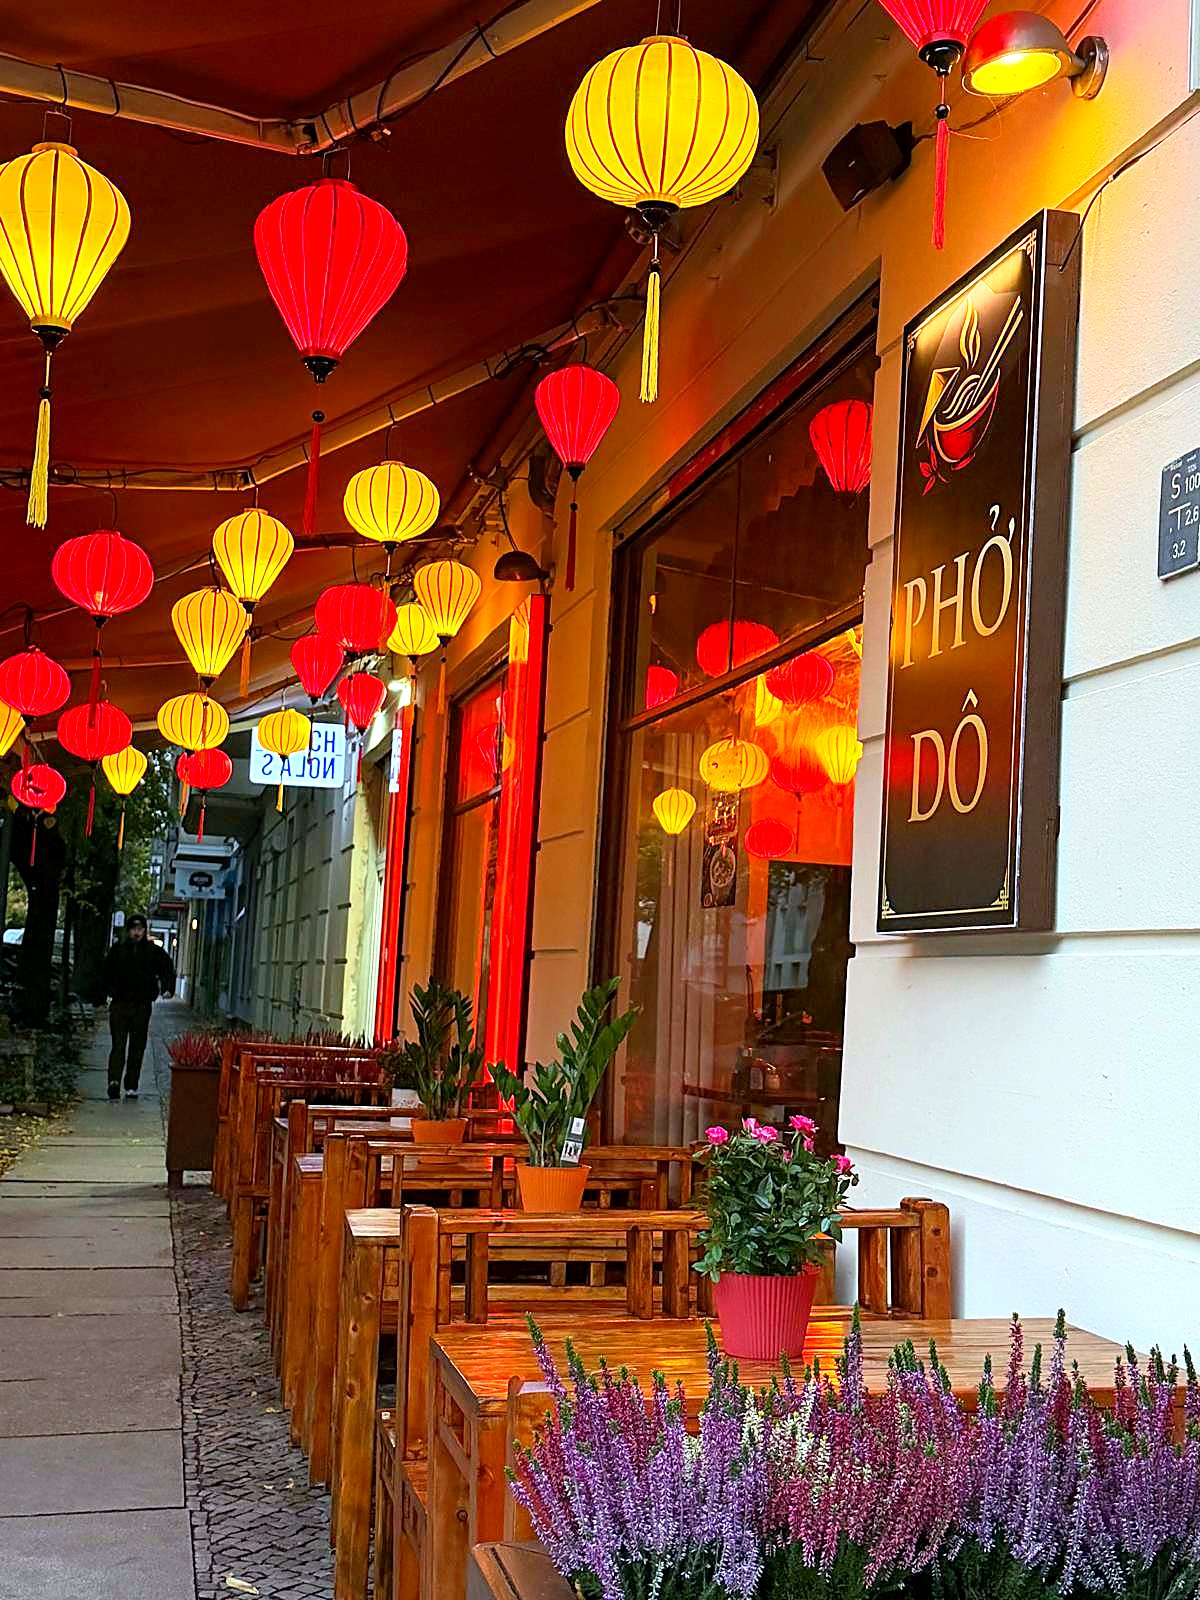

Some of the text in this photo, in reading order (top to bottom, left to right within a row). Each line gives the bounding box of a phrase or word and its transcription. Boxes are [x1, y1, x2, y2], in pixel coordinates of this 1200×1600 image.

[1171, 472, 1181, 499] S
[900, 504, 1015, 670] PHỞ
[907, 688, 989, 823] DÔ
